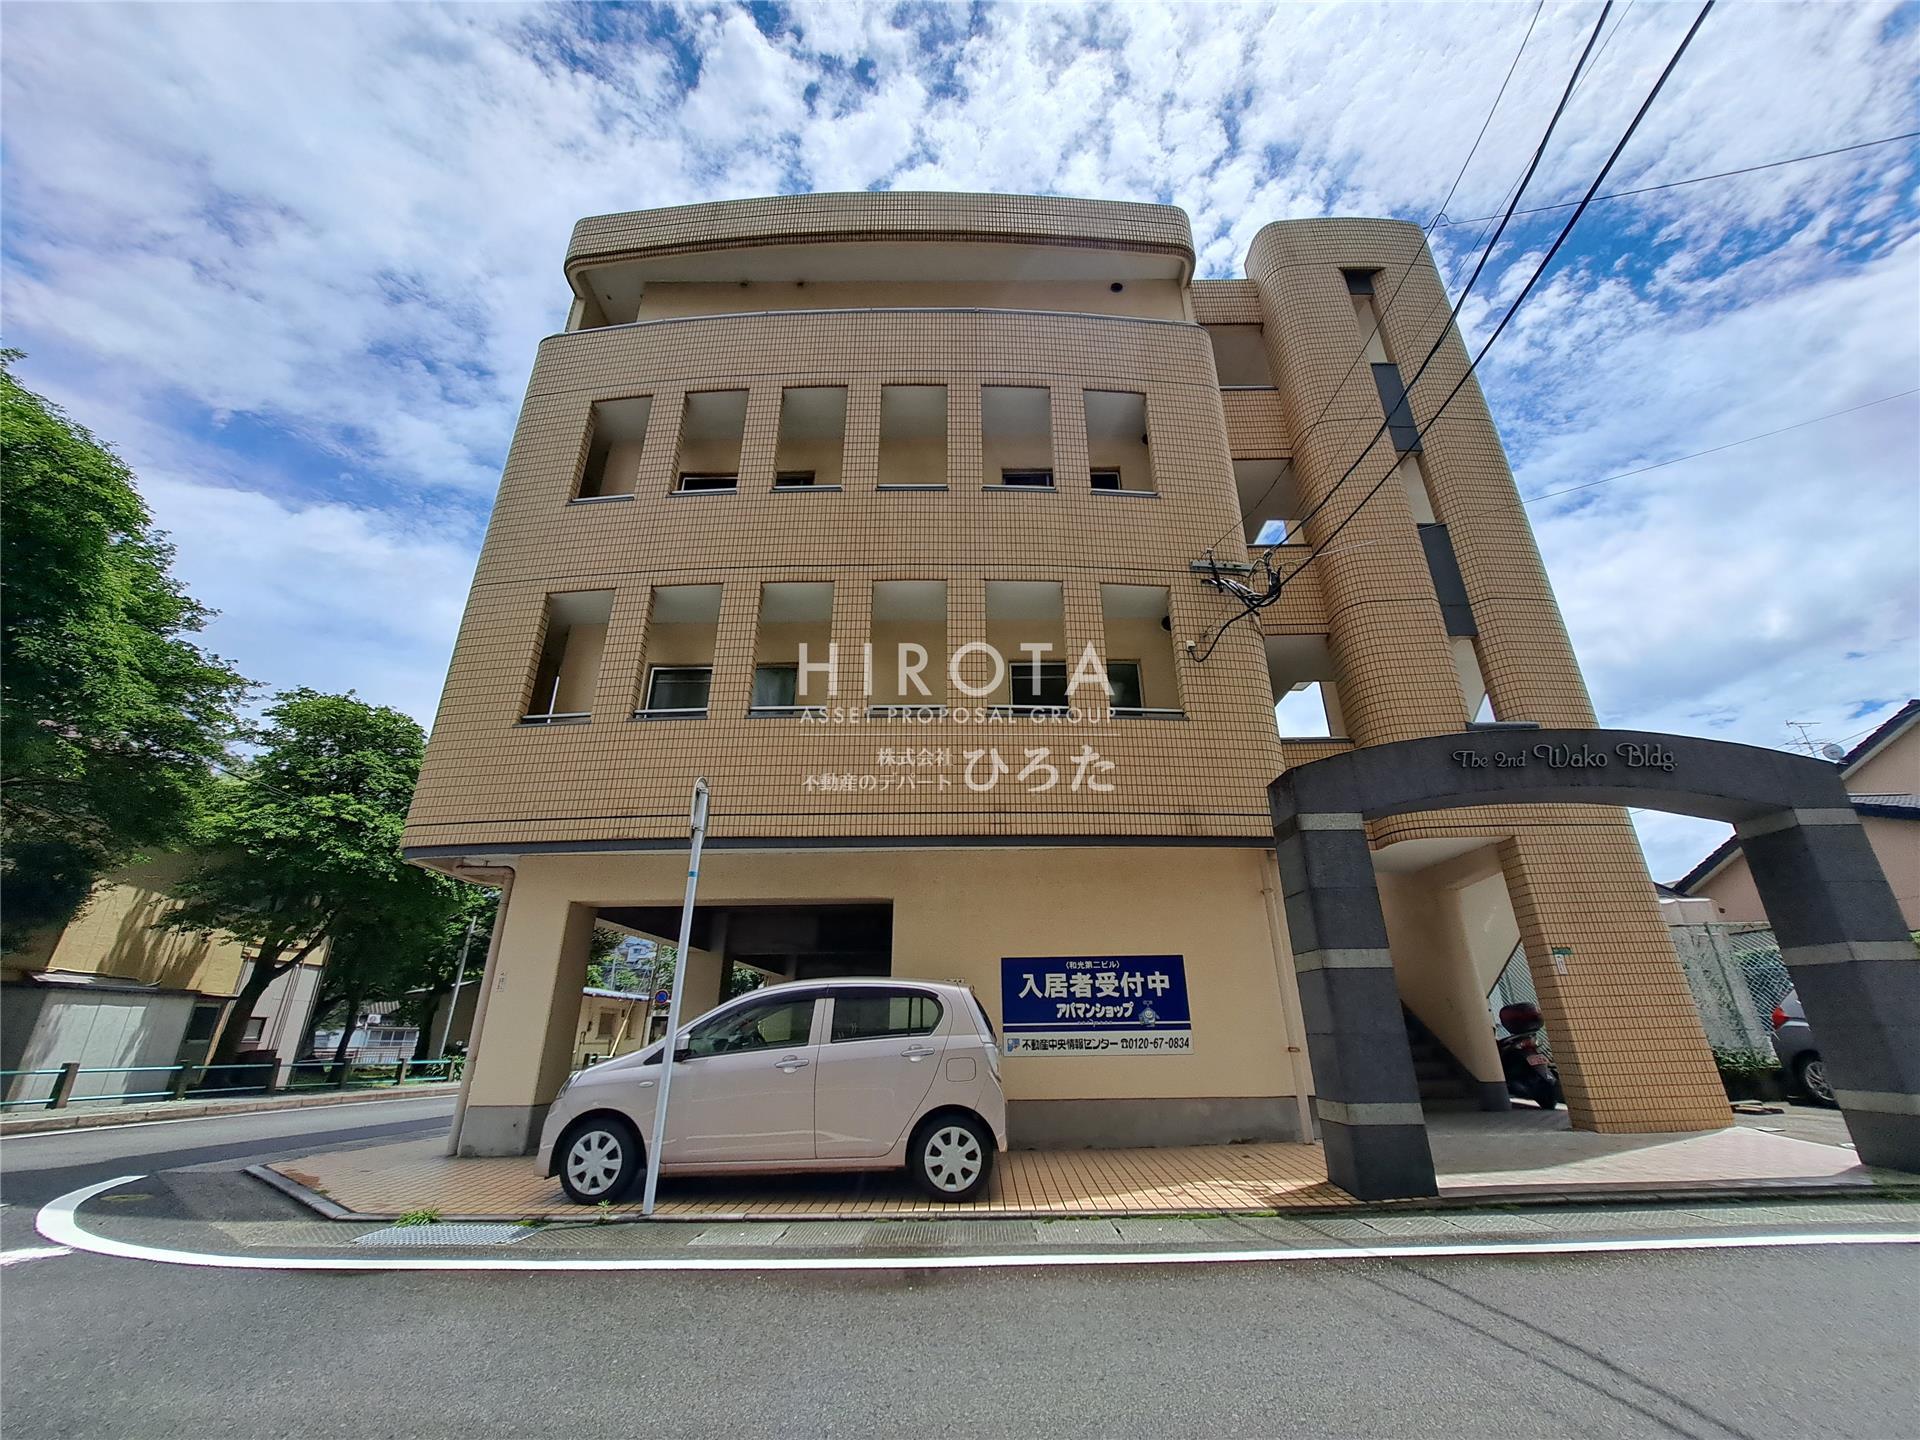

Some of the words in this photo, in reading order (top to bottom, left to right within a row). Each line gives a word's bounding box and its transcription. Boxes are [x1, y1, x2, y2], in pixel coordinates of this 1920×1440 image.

[1452, 750, 1488, 768] The
[1494, 750, 1526, 768] 2nd
[1533, 743, 1608, 769] Wako
[1018, 971, 1170, 998] 入居者受付中
[1056, 1001, 1134, 1018] アパマンショップ
[1022, 1038, 1118, 1050] 不動産中央情報センター
[1128, 1037, 1189, 1049] 0120-67-0834
